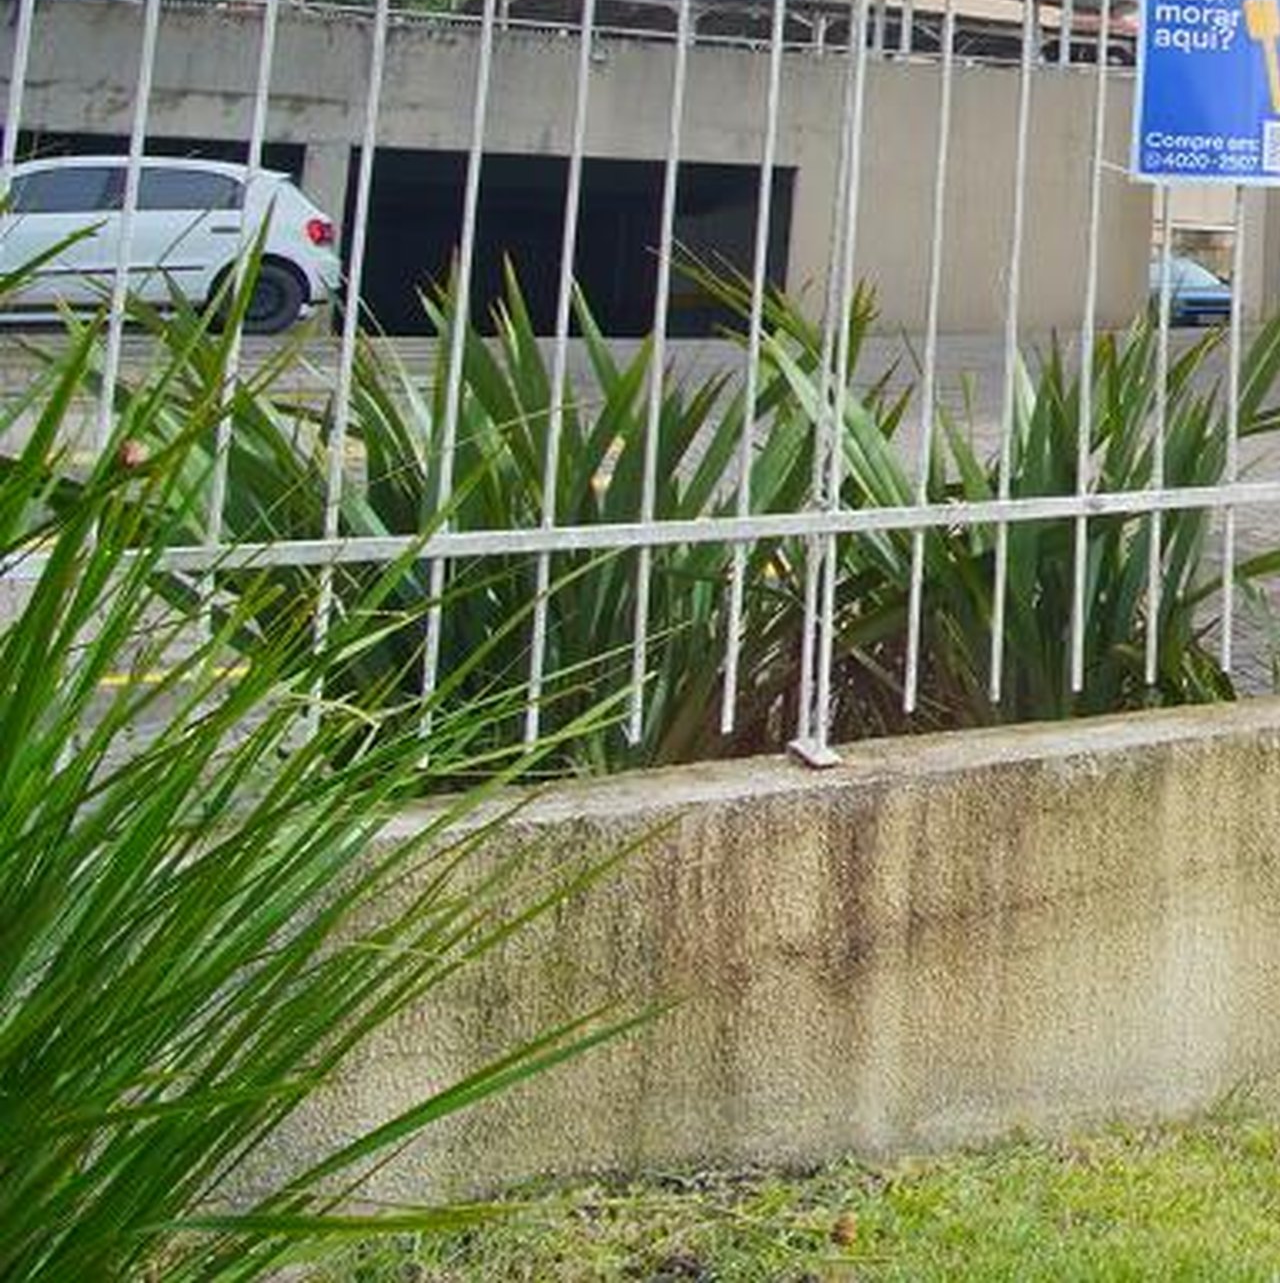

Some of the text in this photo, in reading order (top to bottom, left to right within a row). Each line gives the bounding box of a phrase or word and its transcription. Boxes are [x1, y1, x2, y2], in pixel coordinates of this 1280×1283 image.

[1155, 4, 1240, 28] morar
[1154, 24, 1236, 53] aqui?
[1145, 132, 1224, 151] Compre
